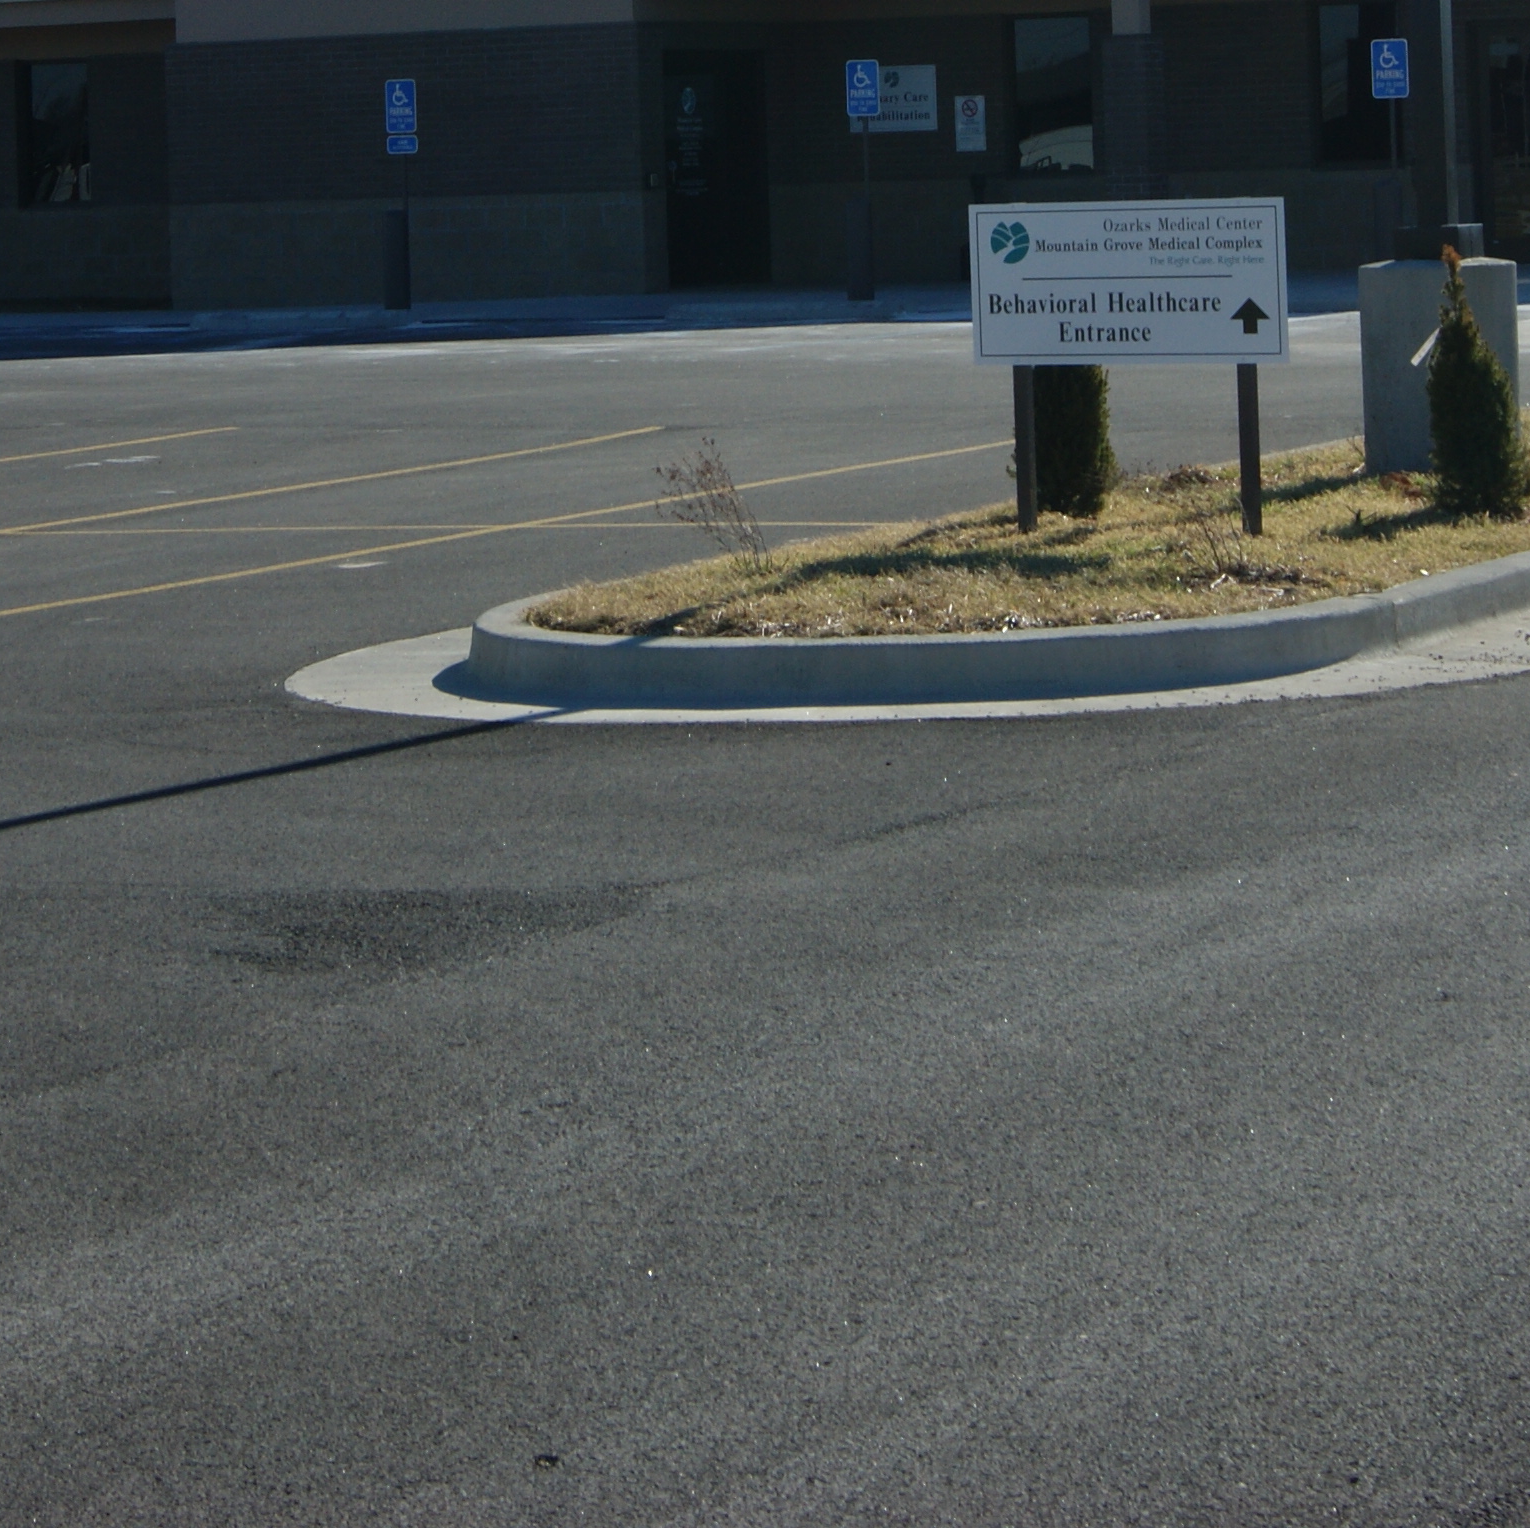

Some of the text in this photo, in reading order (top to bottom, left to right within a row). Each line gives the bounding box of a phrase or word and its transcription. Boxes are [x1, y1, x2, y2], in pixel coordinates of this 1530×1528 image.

[904, 91, 929, 103] Care
[857, 110, 931, 122] abilitation
[1103, 216, 1263, 233] Ozarks Medical Center
[1035, 235, 1263, 253] Mountain Grove Medical Complex
[1150, 256, 1165, 265] The
[1167, 256, 1190, 267] Right
[1217, 255, 1240, 267] Right
[1242, 255, 1265, 264] Here
[988, 291, 1222, 315] Behavioral Healthcare
[1059, 322, 1152, 343] Entrance
